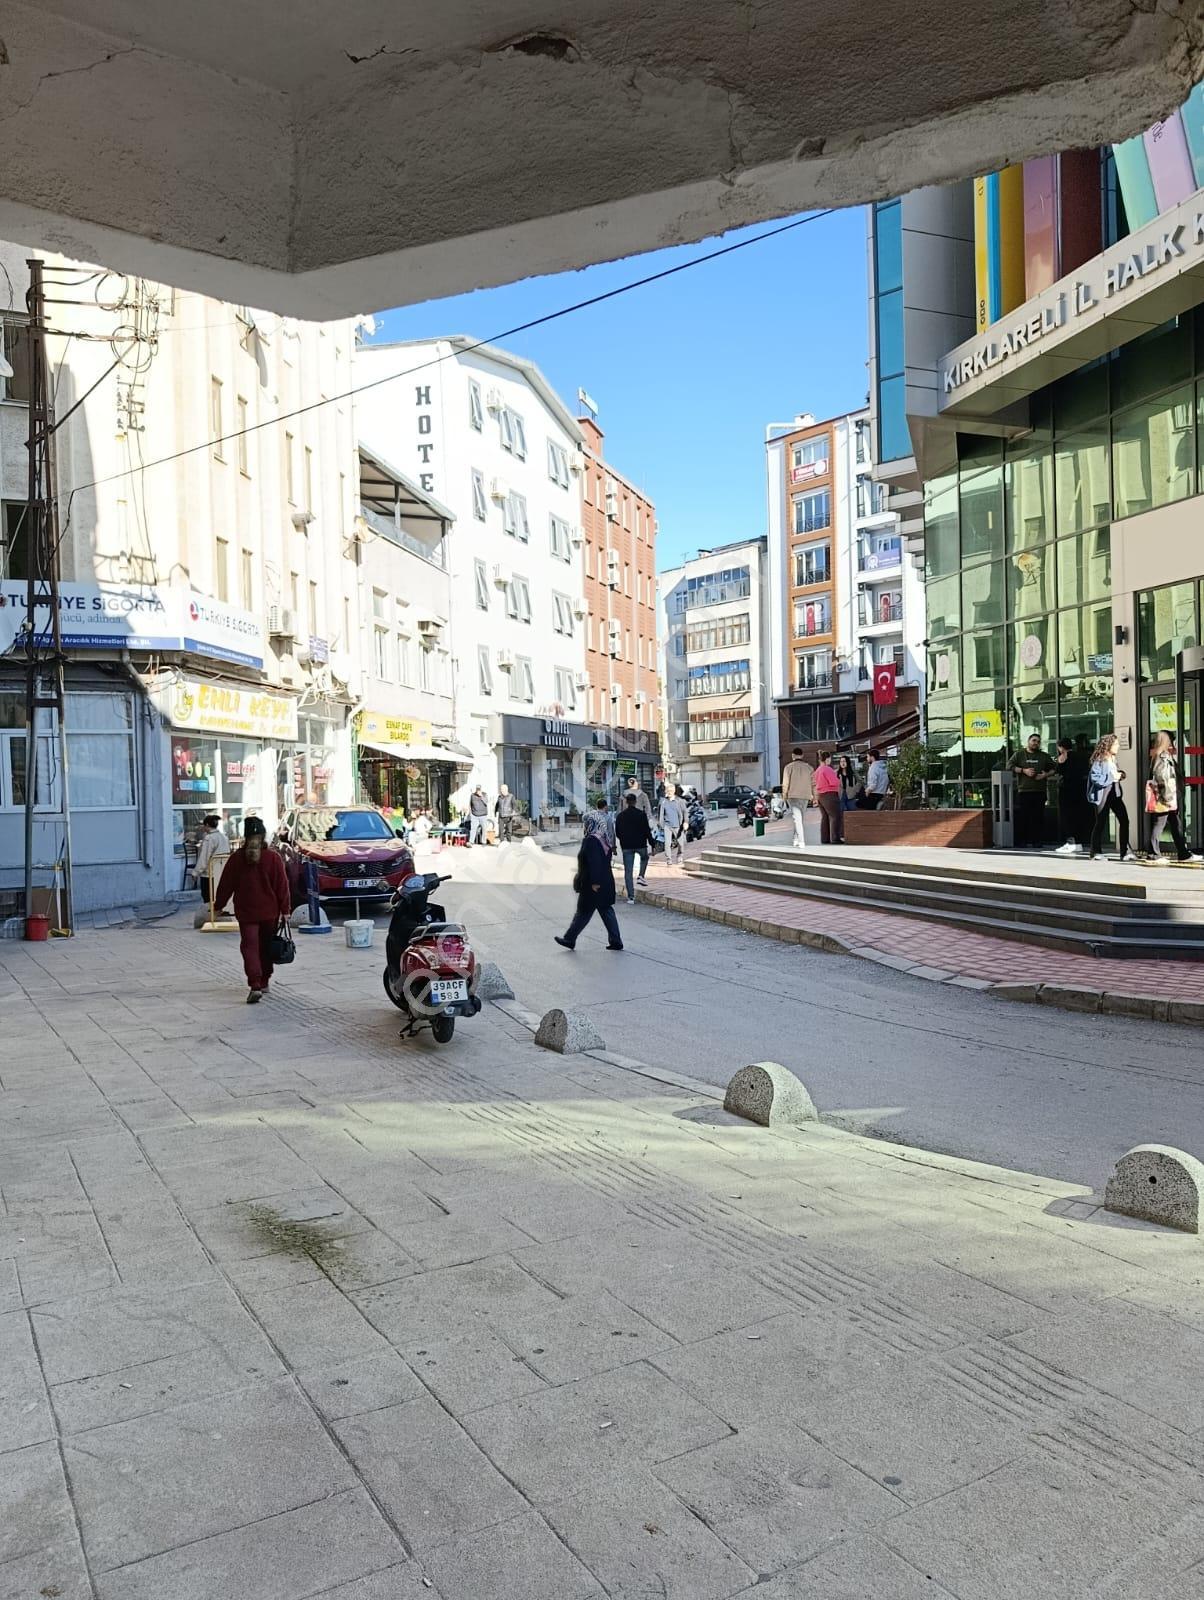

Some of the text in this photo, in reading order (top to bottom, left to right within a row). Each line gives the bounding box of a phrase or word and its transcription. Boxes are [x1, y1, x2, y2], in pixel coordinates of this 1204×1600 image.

[943, 292, 1065, 394] KIRKLARELİ
[1071, 281, 1097, 317] İL
[1104, 224, 1184, 298] HALK
[433, 981, 464, 991] 39ACF
[440, 991, 460, 1001] 583
